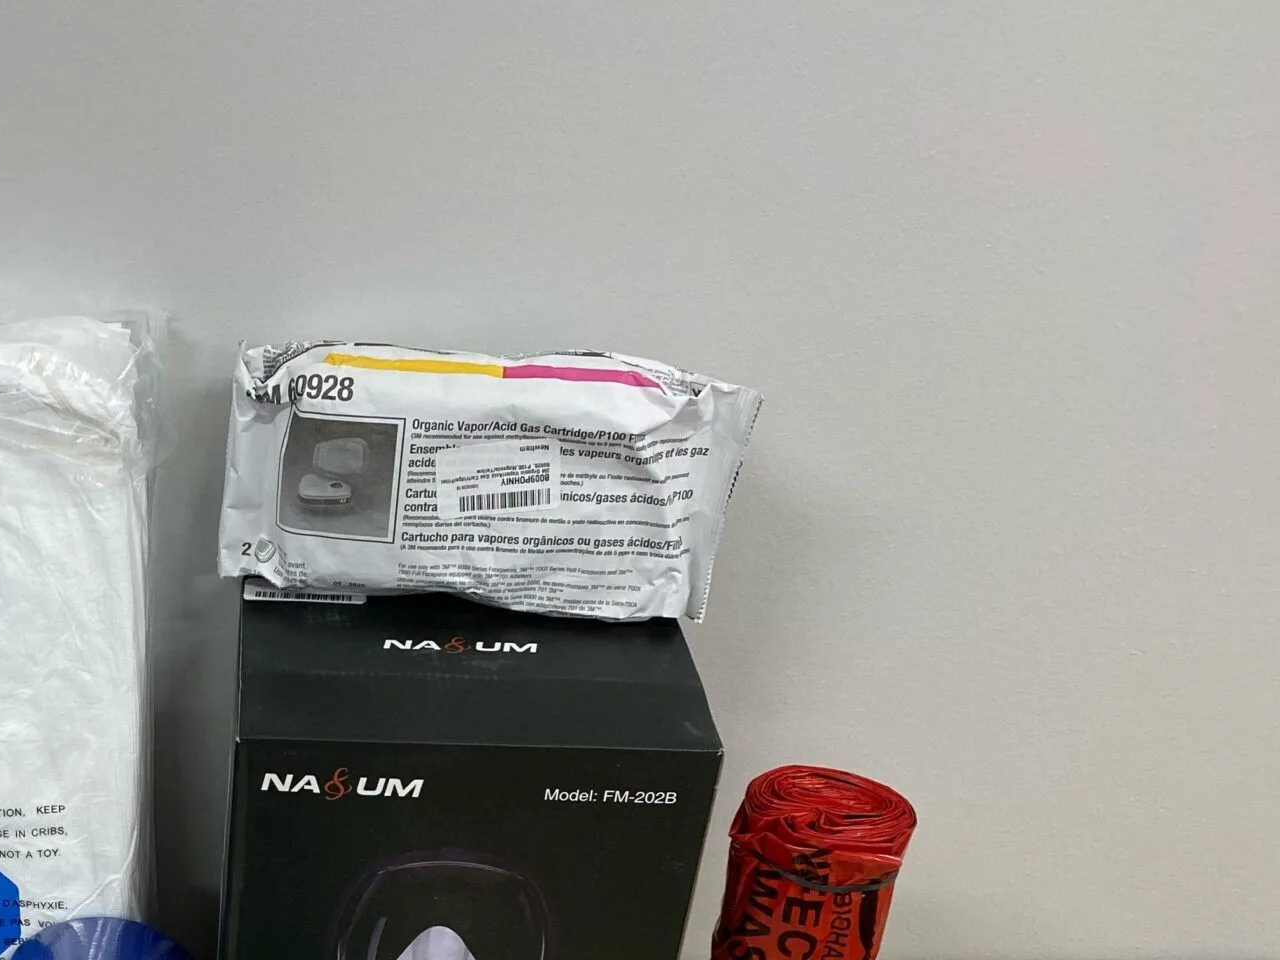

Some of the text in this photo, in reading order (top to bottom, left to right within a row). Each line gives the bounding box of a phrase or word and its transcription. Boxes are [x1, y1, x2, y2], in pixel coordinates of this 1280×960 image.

[412, 418, 454, 432] Organic
[457, 420, 517, 435] Vapor/Acid
[520, 422, 540, 433] Gas
[543, 424, 627, 441] Cartridge/P100
[578, 449, 621, 462] vapeurs
[690, 447, 709, 460] gaz
[672, 489, 693, 501] P100
[404, 502, 438, 512] contra
[401, 531, 448, 543] Cartucho
[451, 534, 475, 546] para
[478, 535, 519, 548] vapores
[522, 536, 574, 550] orgânicos
[577, 539, 590, 547] ou
[593, 539, 624, 551] gases
[241, 542, 252, 556] 2
[543, 788, 678, 805] Model: FM-202B
[36, 804, 66, 815] KEEP
[15, 830, 26, 839] IN
[0, 850, 21, 859] NOT
[25, 850, 34, 859] A
[10, 918, 31, 927] PAS
